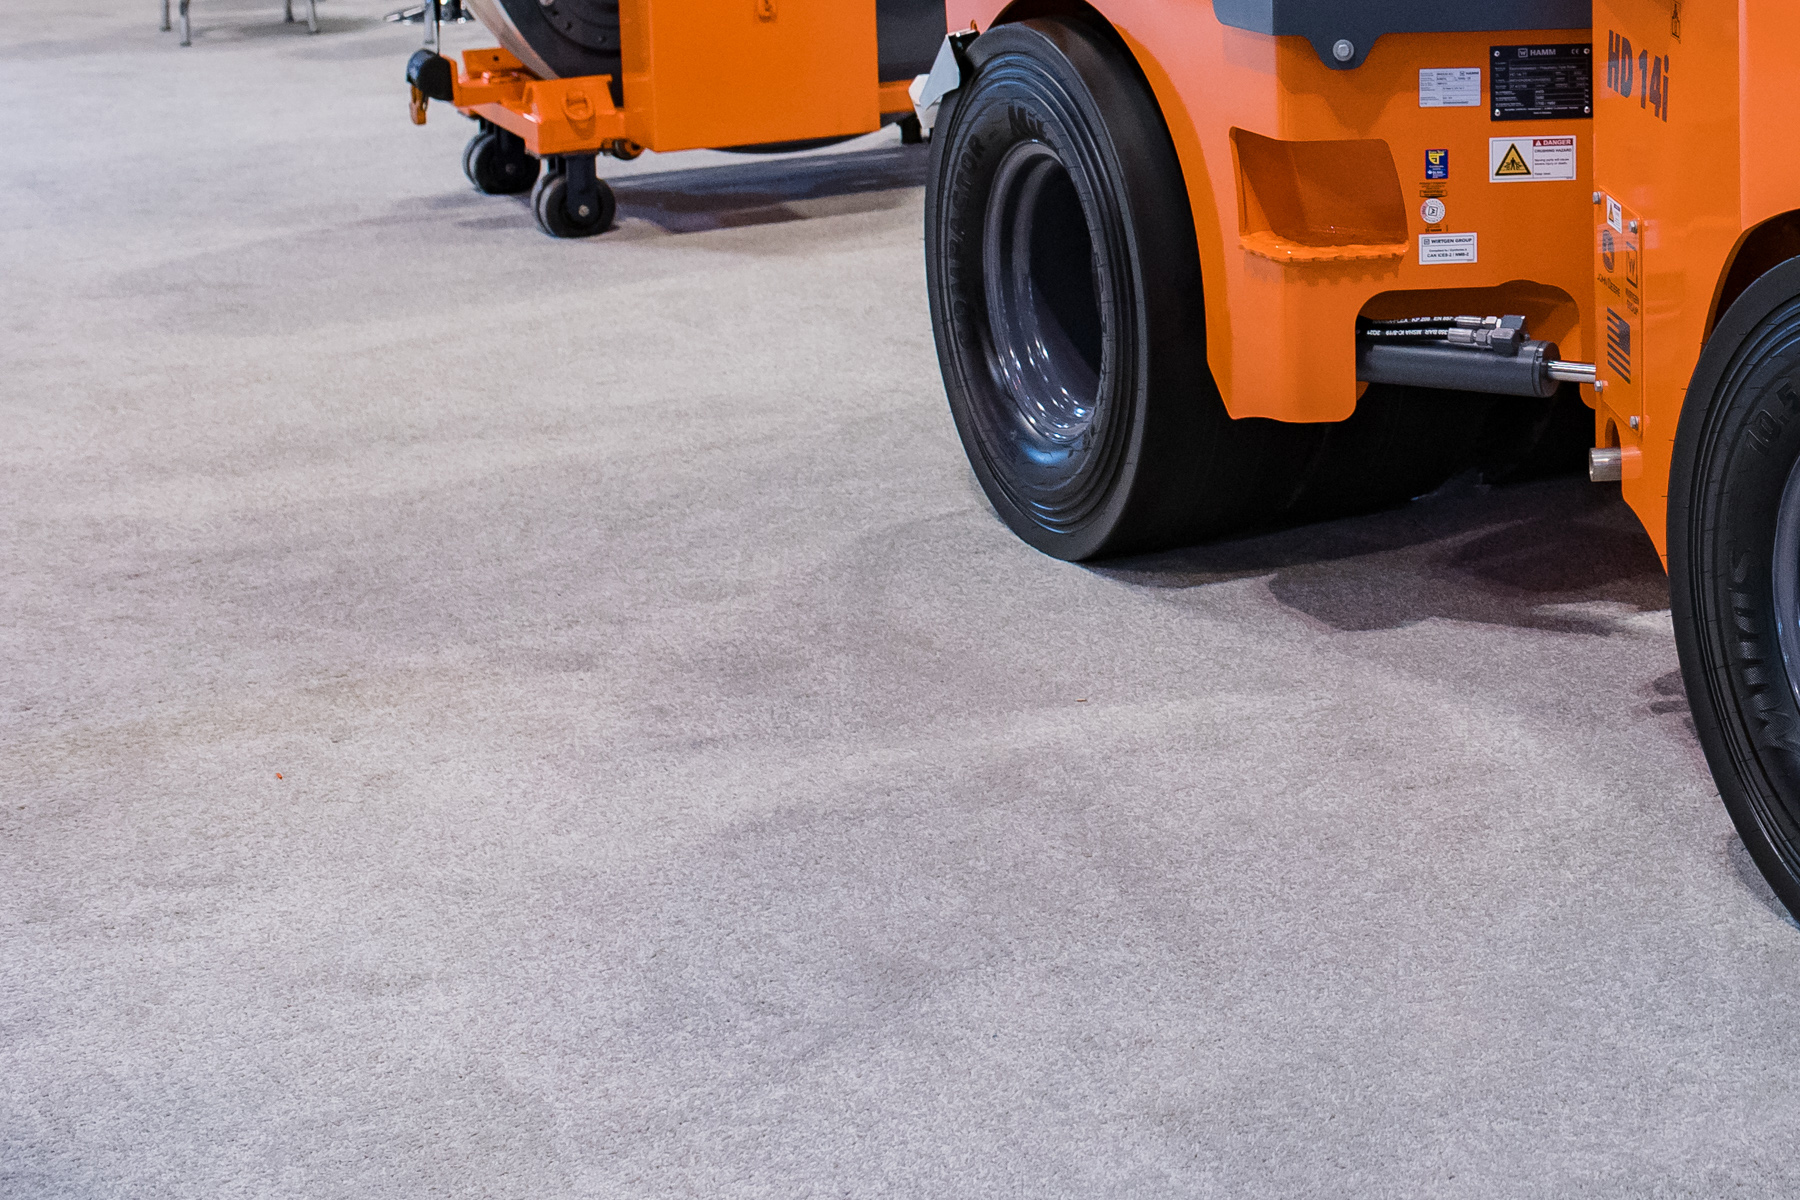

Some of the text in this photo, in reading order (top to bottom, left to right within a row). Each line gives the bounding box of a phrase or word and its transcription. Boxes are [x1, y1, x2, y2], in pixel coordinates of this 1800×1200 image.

[1530, 48, 1556, 56] HAMM
[1607, 29, 1670, 123] HD 14i
[1543, 138, 1572, 146] DANGER
